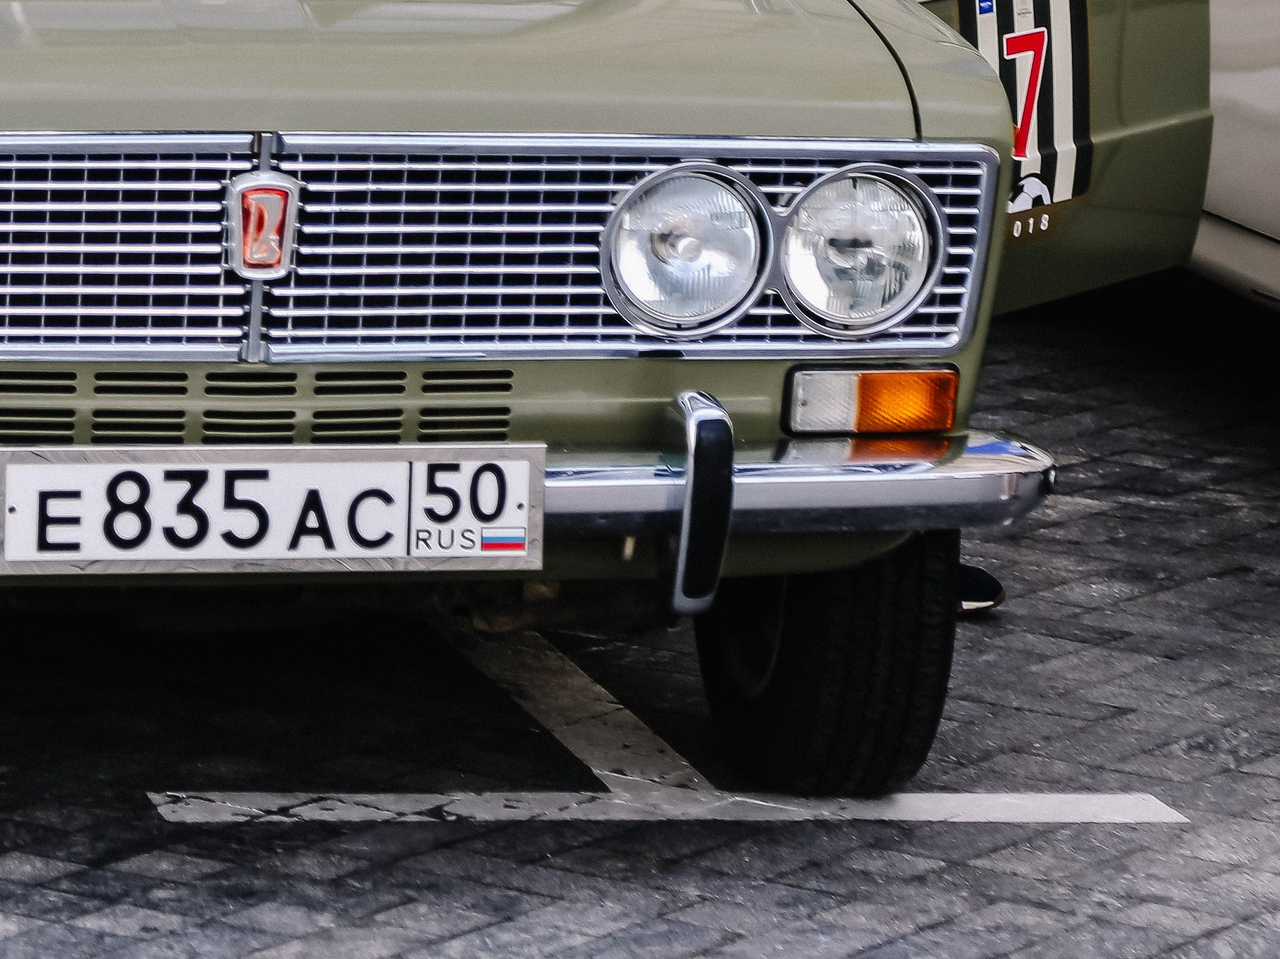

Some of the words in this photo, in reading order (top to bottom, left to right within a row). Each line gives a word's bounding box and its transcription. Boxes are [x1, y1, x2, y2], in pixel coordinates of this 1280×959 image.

[1003, 26, 1048, 161] 7
[1013, 213, 1050, 239] 018
[423, 461, 509, 523] 50
[415, 528, 478, 550] RUS
